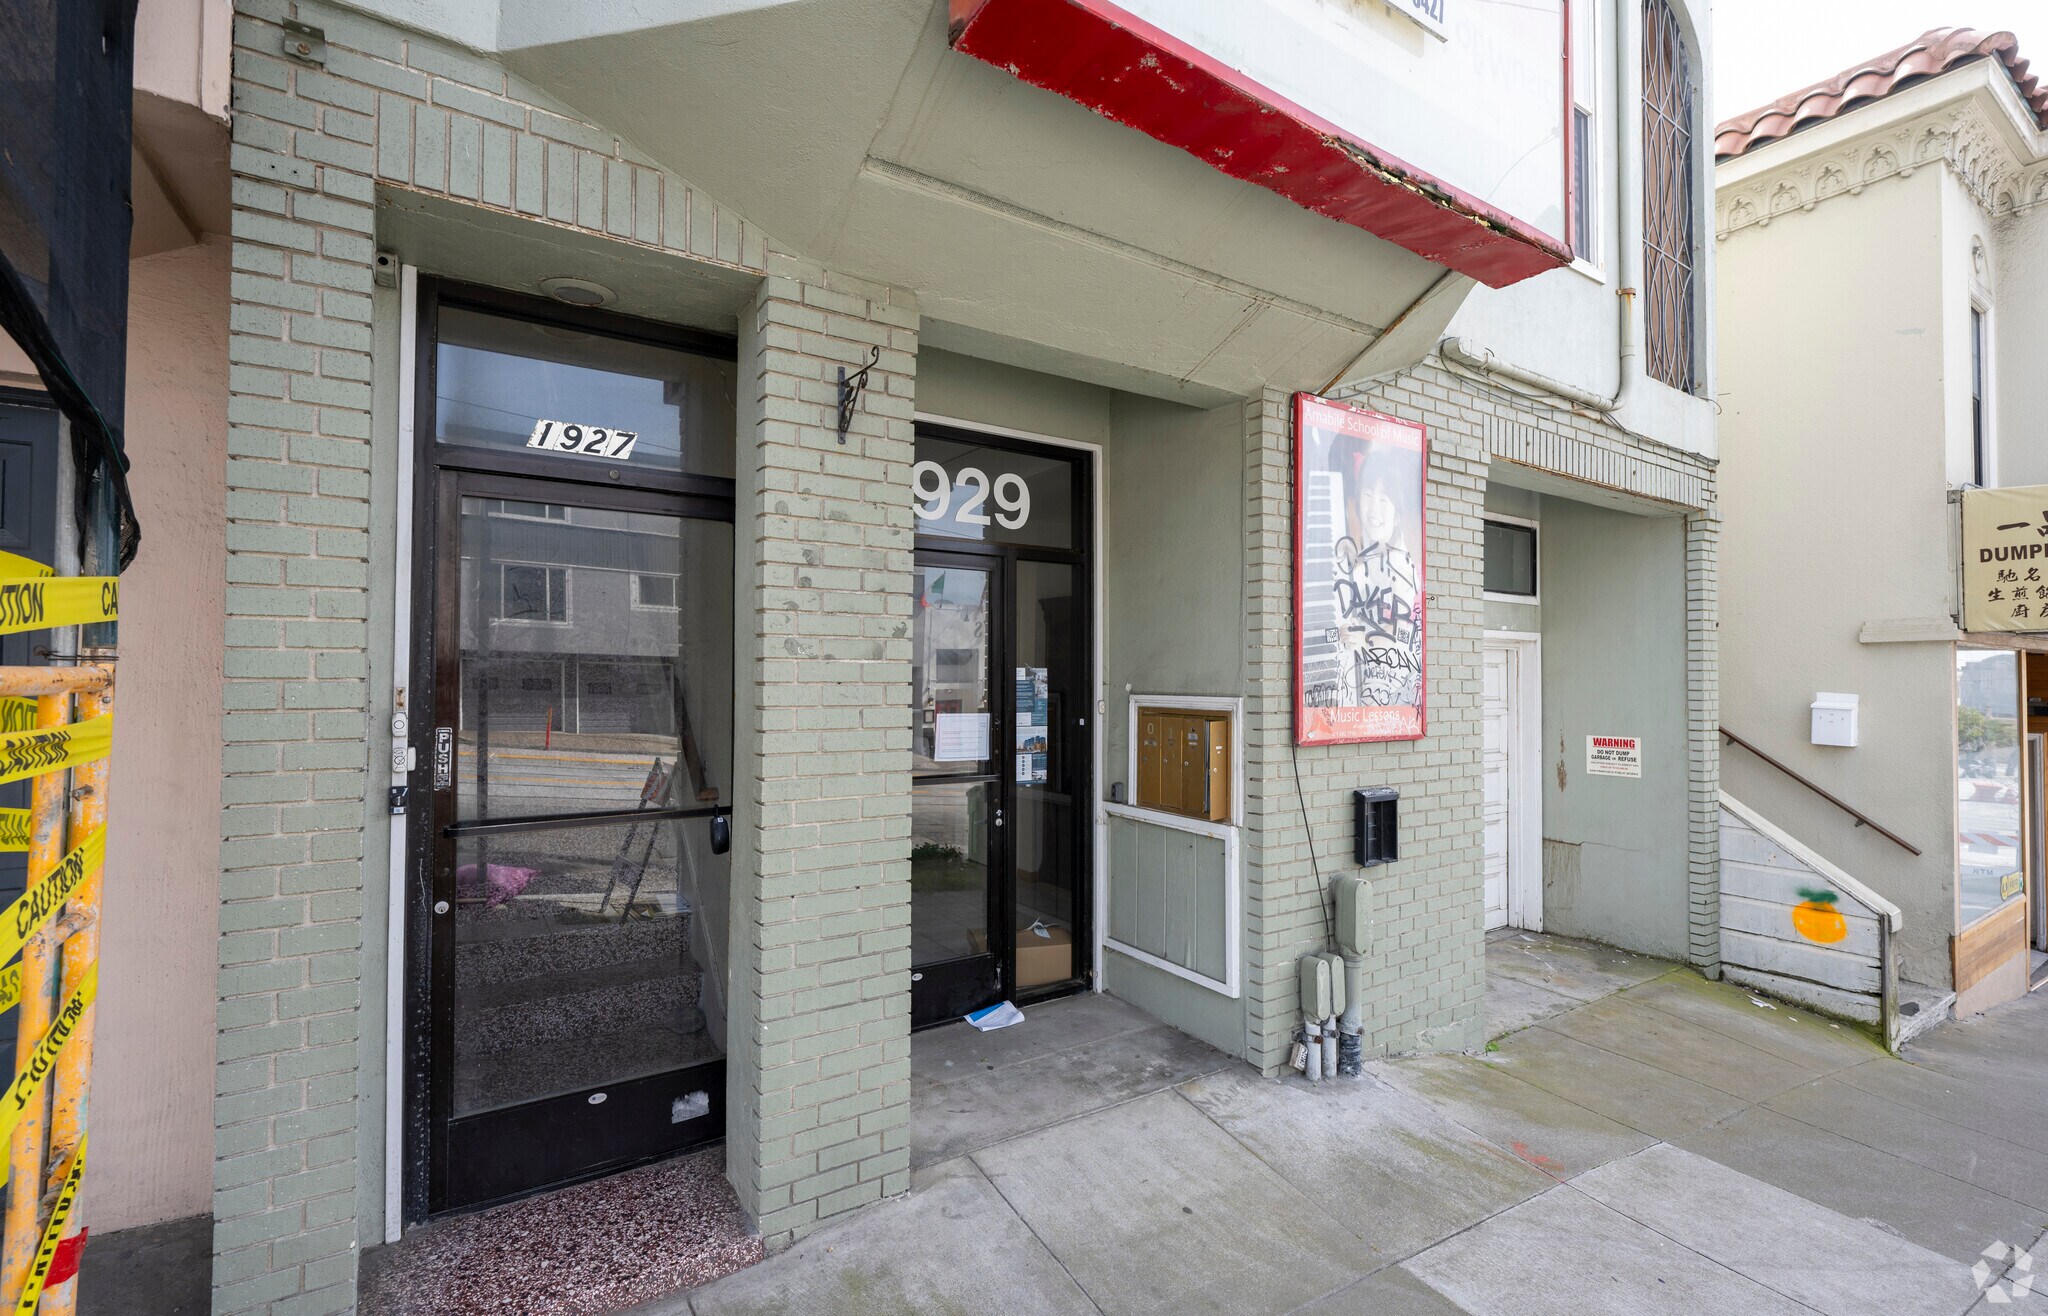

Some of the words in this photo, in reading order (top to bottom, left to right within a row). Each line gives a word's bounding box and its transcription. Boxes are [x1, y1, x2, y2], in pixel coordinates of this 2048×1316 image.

[538, 422, 636, 456] 1927
[1304, 407, 1345, 428] Amabile
[1347, 417, 1379, 437] School
[1381, 427, 1391, 439] of
[1393, 428, 1419, 446] Music
[1330, 708, 1360, 723] Music
[1362, 709, 1400, 722] Lessons
[437, 732, 450, 774] PUSH
[1593, 737, 1635, 749] WARNING
[17, 847, 85, 940] CAUTION
